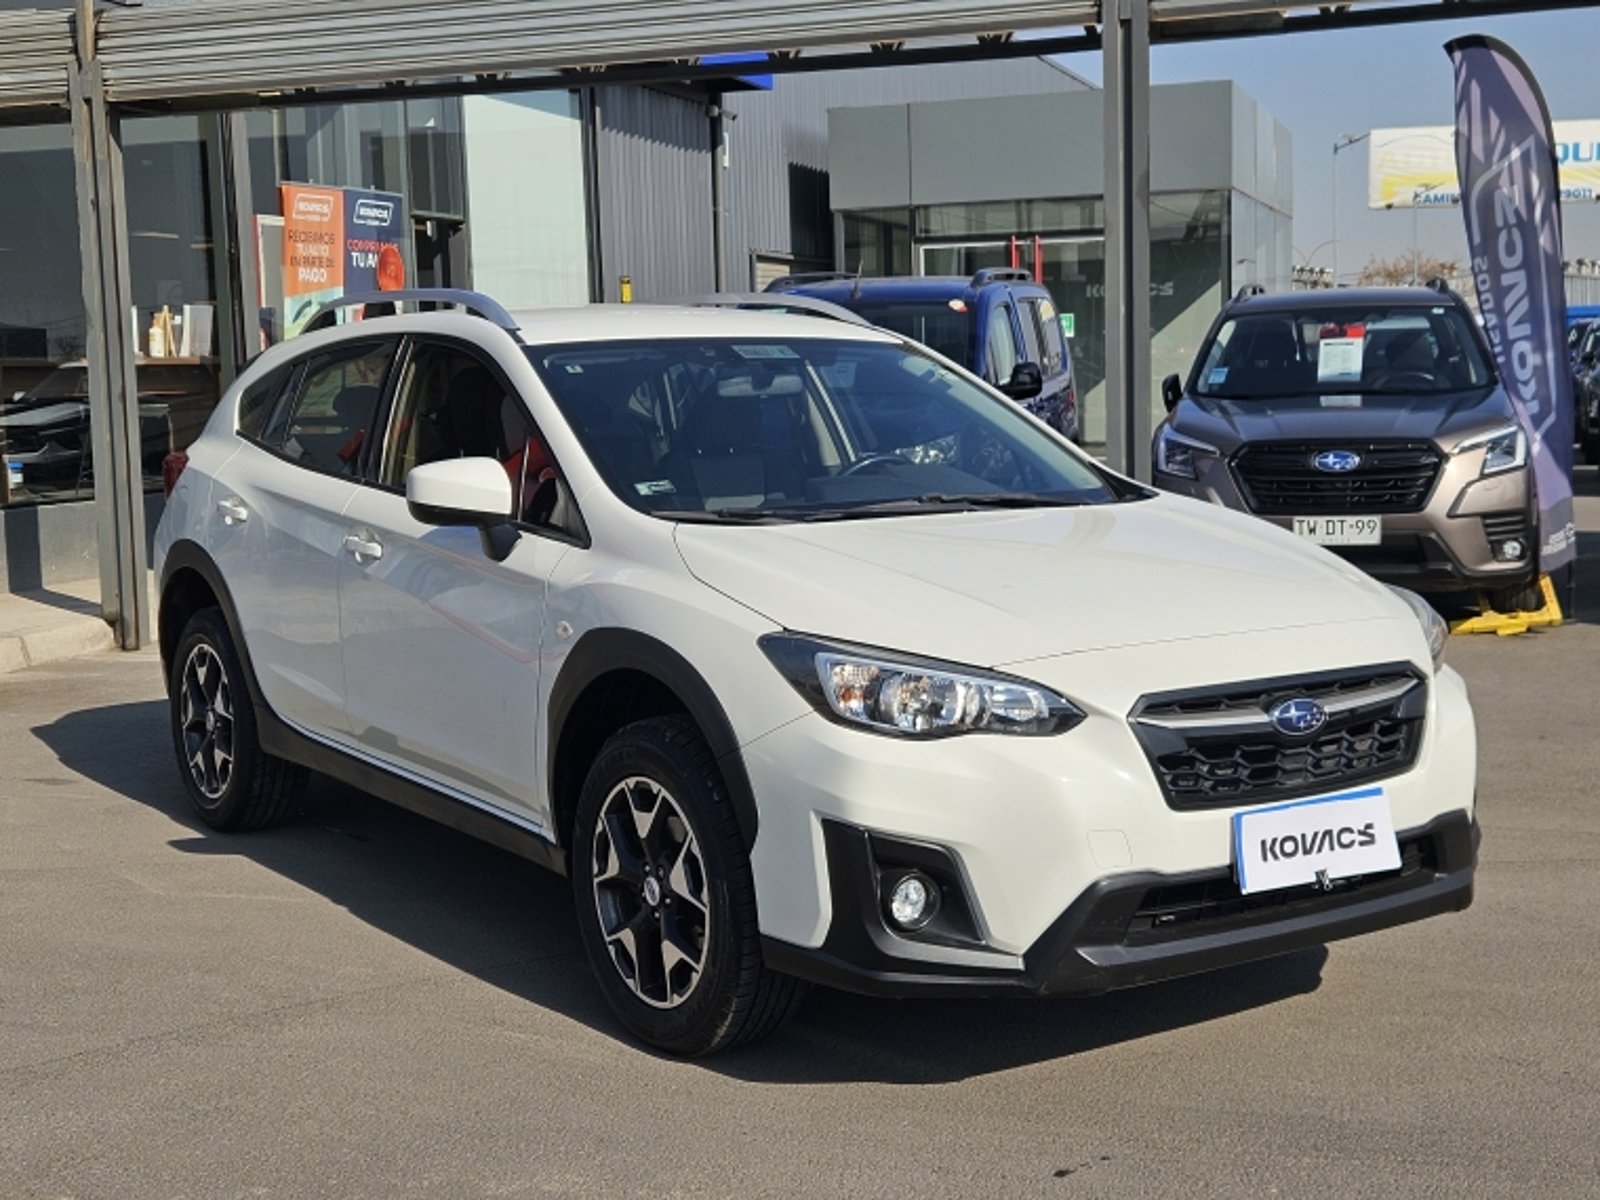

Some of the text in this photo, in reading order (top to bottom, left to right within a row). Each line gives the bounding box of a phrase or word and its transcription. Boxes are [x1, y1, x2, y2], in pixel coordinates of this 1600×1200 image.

[351, 252, 365, 268] TU
[299, 268, 327, 282] PAGO
[1260, 822, 1376, 862] KOVACS
